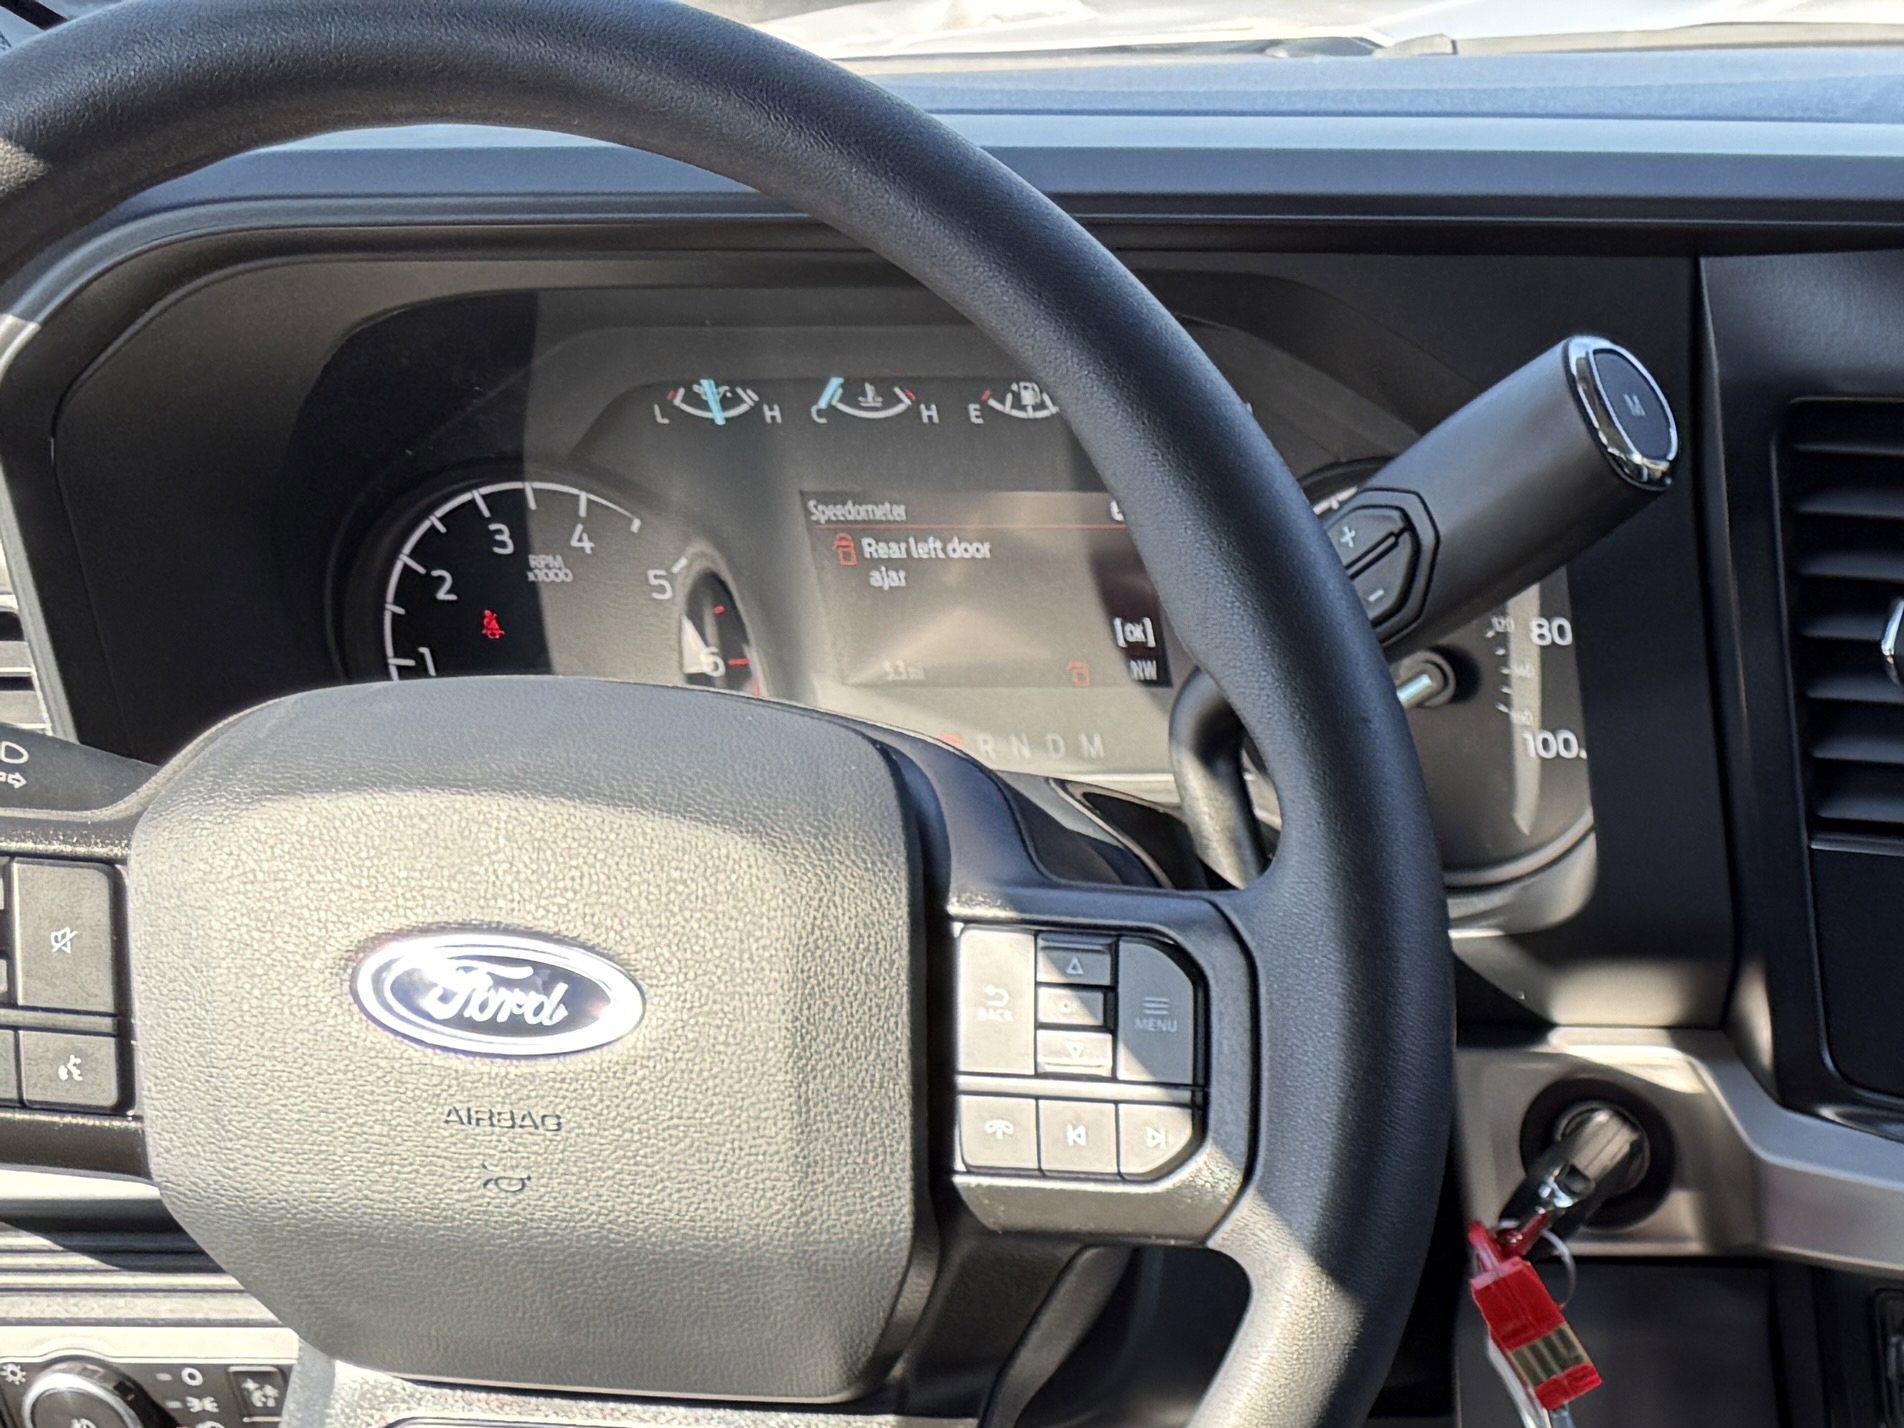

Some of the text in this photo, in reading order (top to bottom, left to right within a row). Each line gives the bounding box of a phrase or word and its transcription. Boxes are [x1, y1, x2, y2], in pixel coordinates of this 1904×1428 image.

[654, 404, 669, 424] L
[763, 404, 782, 423] H
[922, 404, 939, 423] H
[969, 404, 984, 424] E
[807, 499, 907, 524] Speedometer
[488, 523, 514, 554] 3
[570, 523, 594, 554] 4
[861, 536, 991, 559] Rear left door
[528, 554, 565, 569] RPM
[431, 569, 458, 601] 2
[647, 569, 673, 600] 5
[869, 565, 907, 590] ajar
[1529, 617, 1573, 646] 80
[418, 647, 436, 676] 1
[700, 647, 726, 677] 6
[1129, 658, 1158, 681] NW
[976, 733, 997, 760] R
[1009, 733, 1031, 759] N
[1046, 733, 1066, 760] D
[1079, 733, 1104, 759] M
[1521, 729, 1579, 759] 100
[426, 965, 569, 1028] Ford
[1134, 1017, 1178, 1034] MENU
[443, 1104, 563, 1134] AIRBAG
